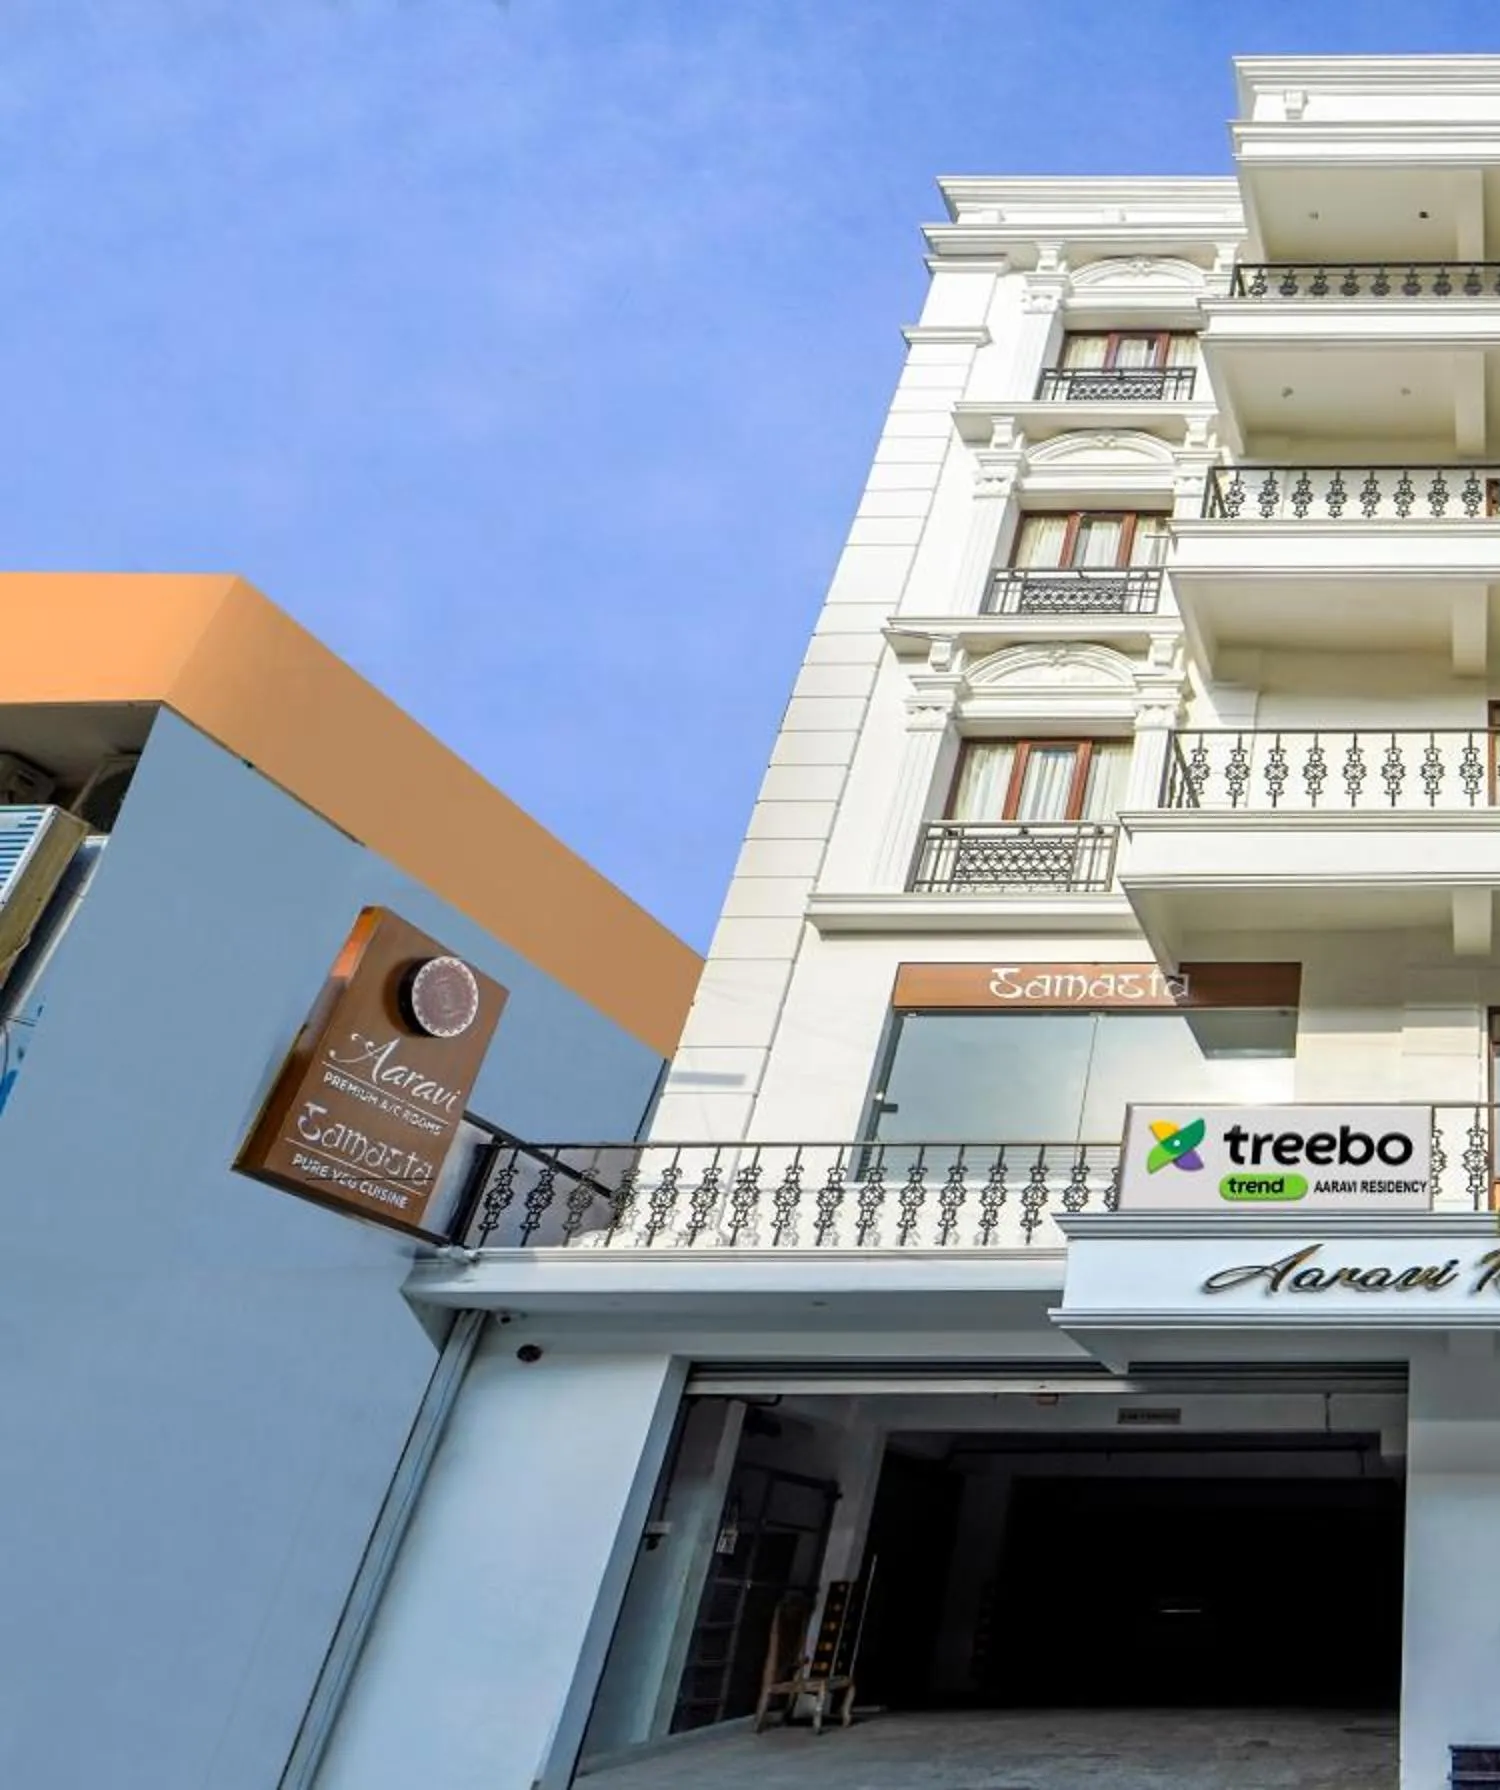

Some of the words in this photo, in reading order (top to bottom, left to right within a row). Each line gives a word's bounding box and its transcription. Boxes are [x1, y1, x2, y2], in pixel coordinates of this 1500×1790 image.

[328, 1033, 461, 1113] Aaravi
[323, 1071, 378, 1105] PREMIUM
[379, 1099, 401, 1117] A/C
[402, 1107, 443, 1135] ROOMS
[1223, 1125, 1413, 1166] treebo
[292, 1153, 328, 1178] PURE
[331, 1169, 357, 1190] VEG
[359, 1181, 409, 1209] CUISINE
[1228, 1177, 1285, 1194] trend
[1313, 1180, 1358, 1193] AARAVI
[1360, 1179, 1428, 1193] RESIDENCY
[1201, 1243, 1458, 1294] Aaravi
